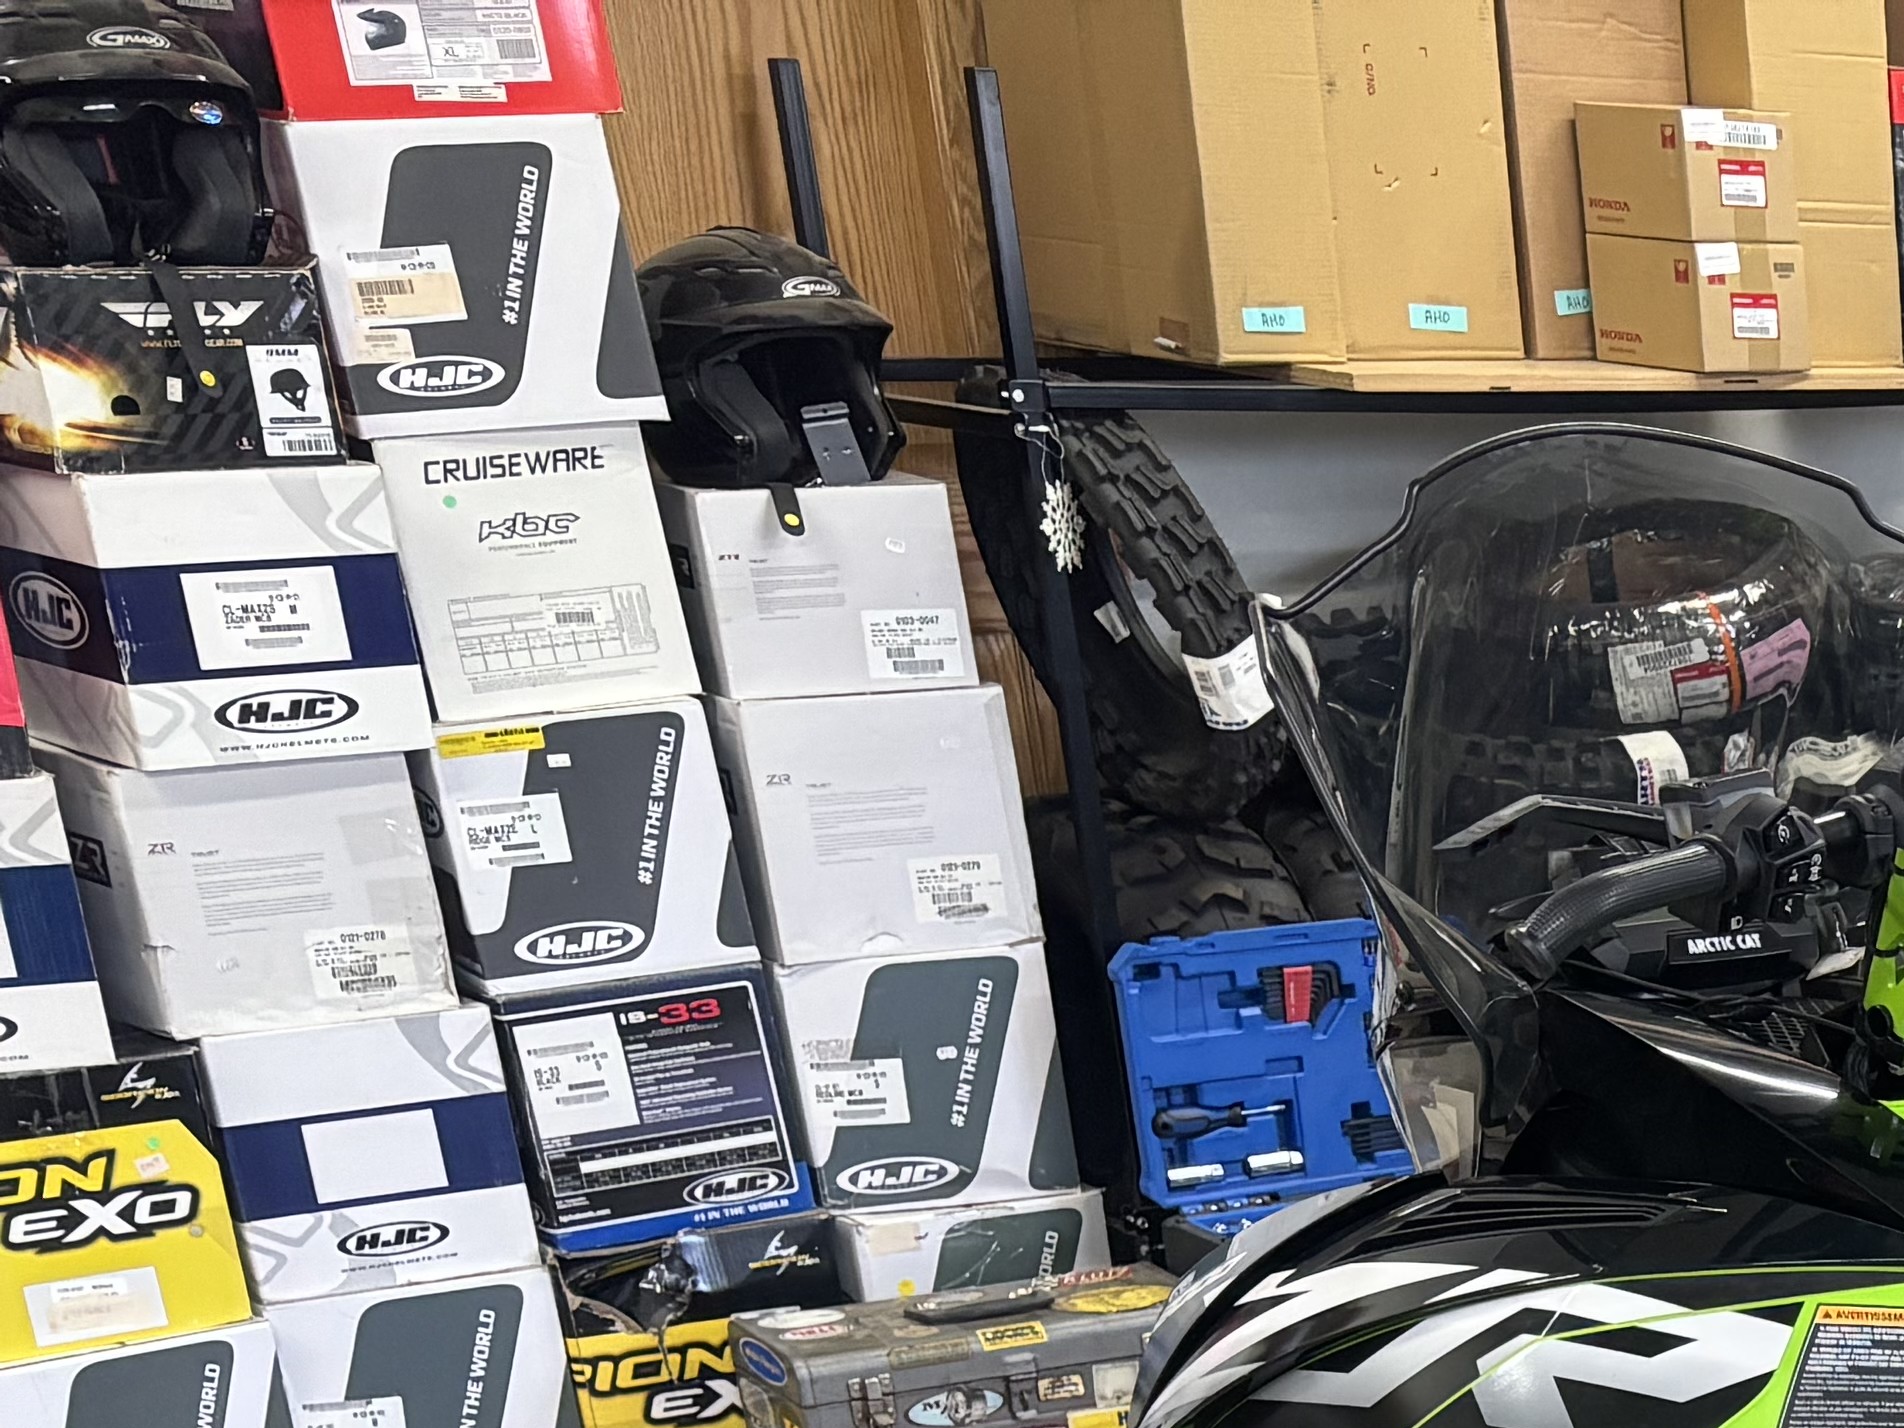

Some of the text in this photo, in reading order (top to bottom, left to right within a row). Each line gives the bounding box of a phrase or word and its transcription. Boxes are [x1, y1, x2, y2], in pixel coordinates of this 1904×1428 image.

[1589, 197, 1631, 213] HONDA
[501, 165, 539, 325] #1 IN THE WORLD
[1599, 329, 1643, 344] HONDA
[399, 364, 484, 389] HJC
[424, 446, 605, 484] CRUISEWARE
[23, 586, 75, 631] HJC
[237, 697, 335, 726] HJC
[638, 727, 675, 885] #1 IN THE WORLD
[537, 928, 623, 958] HJC
[1688, 933, 1763, 955] ARCTIC CAT
[950, 978, 993, 1127] #1 IN THE WORLD
[0, 1149, 115, 1204] ON
[702, 1174, 772, 1200] HJC
[856, 1164, 941, 1188] HJC
[8, 1190, 194, 1244] EXO
[707, 1210, 721, 1220] IN
[722, 1207, 746, 1218] THE
[748, 1199, 790, 1213] WORLD
[355, 1225, 431, 1250] HJC
[468, 1310, 495, 1379] WORLD
[569, 1347, 735, 1392] PION
[462, 1380, 483, 1416] THE
[650, 1379, 745, 1419] EX
